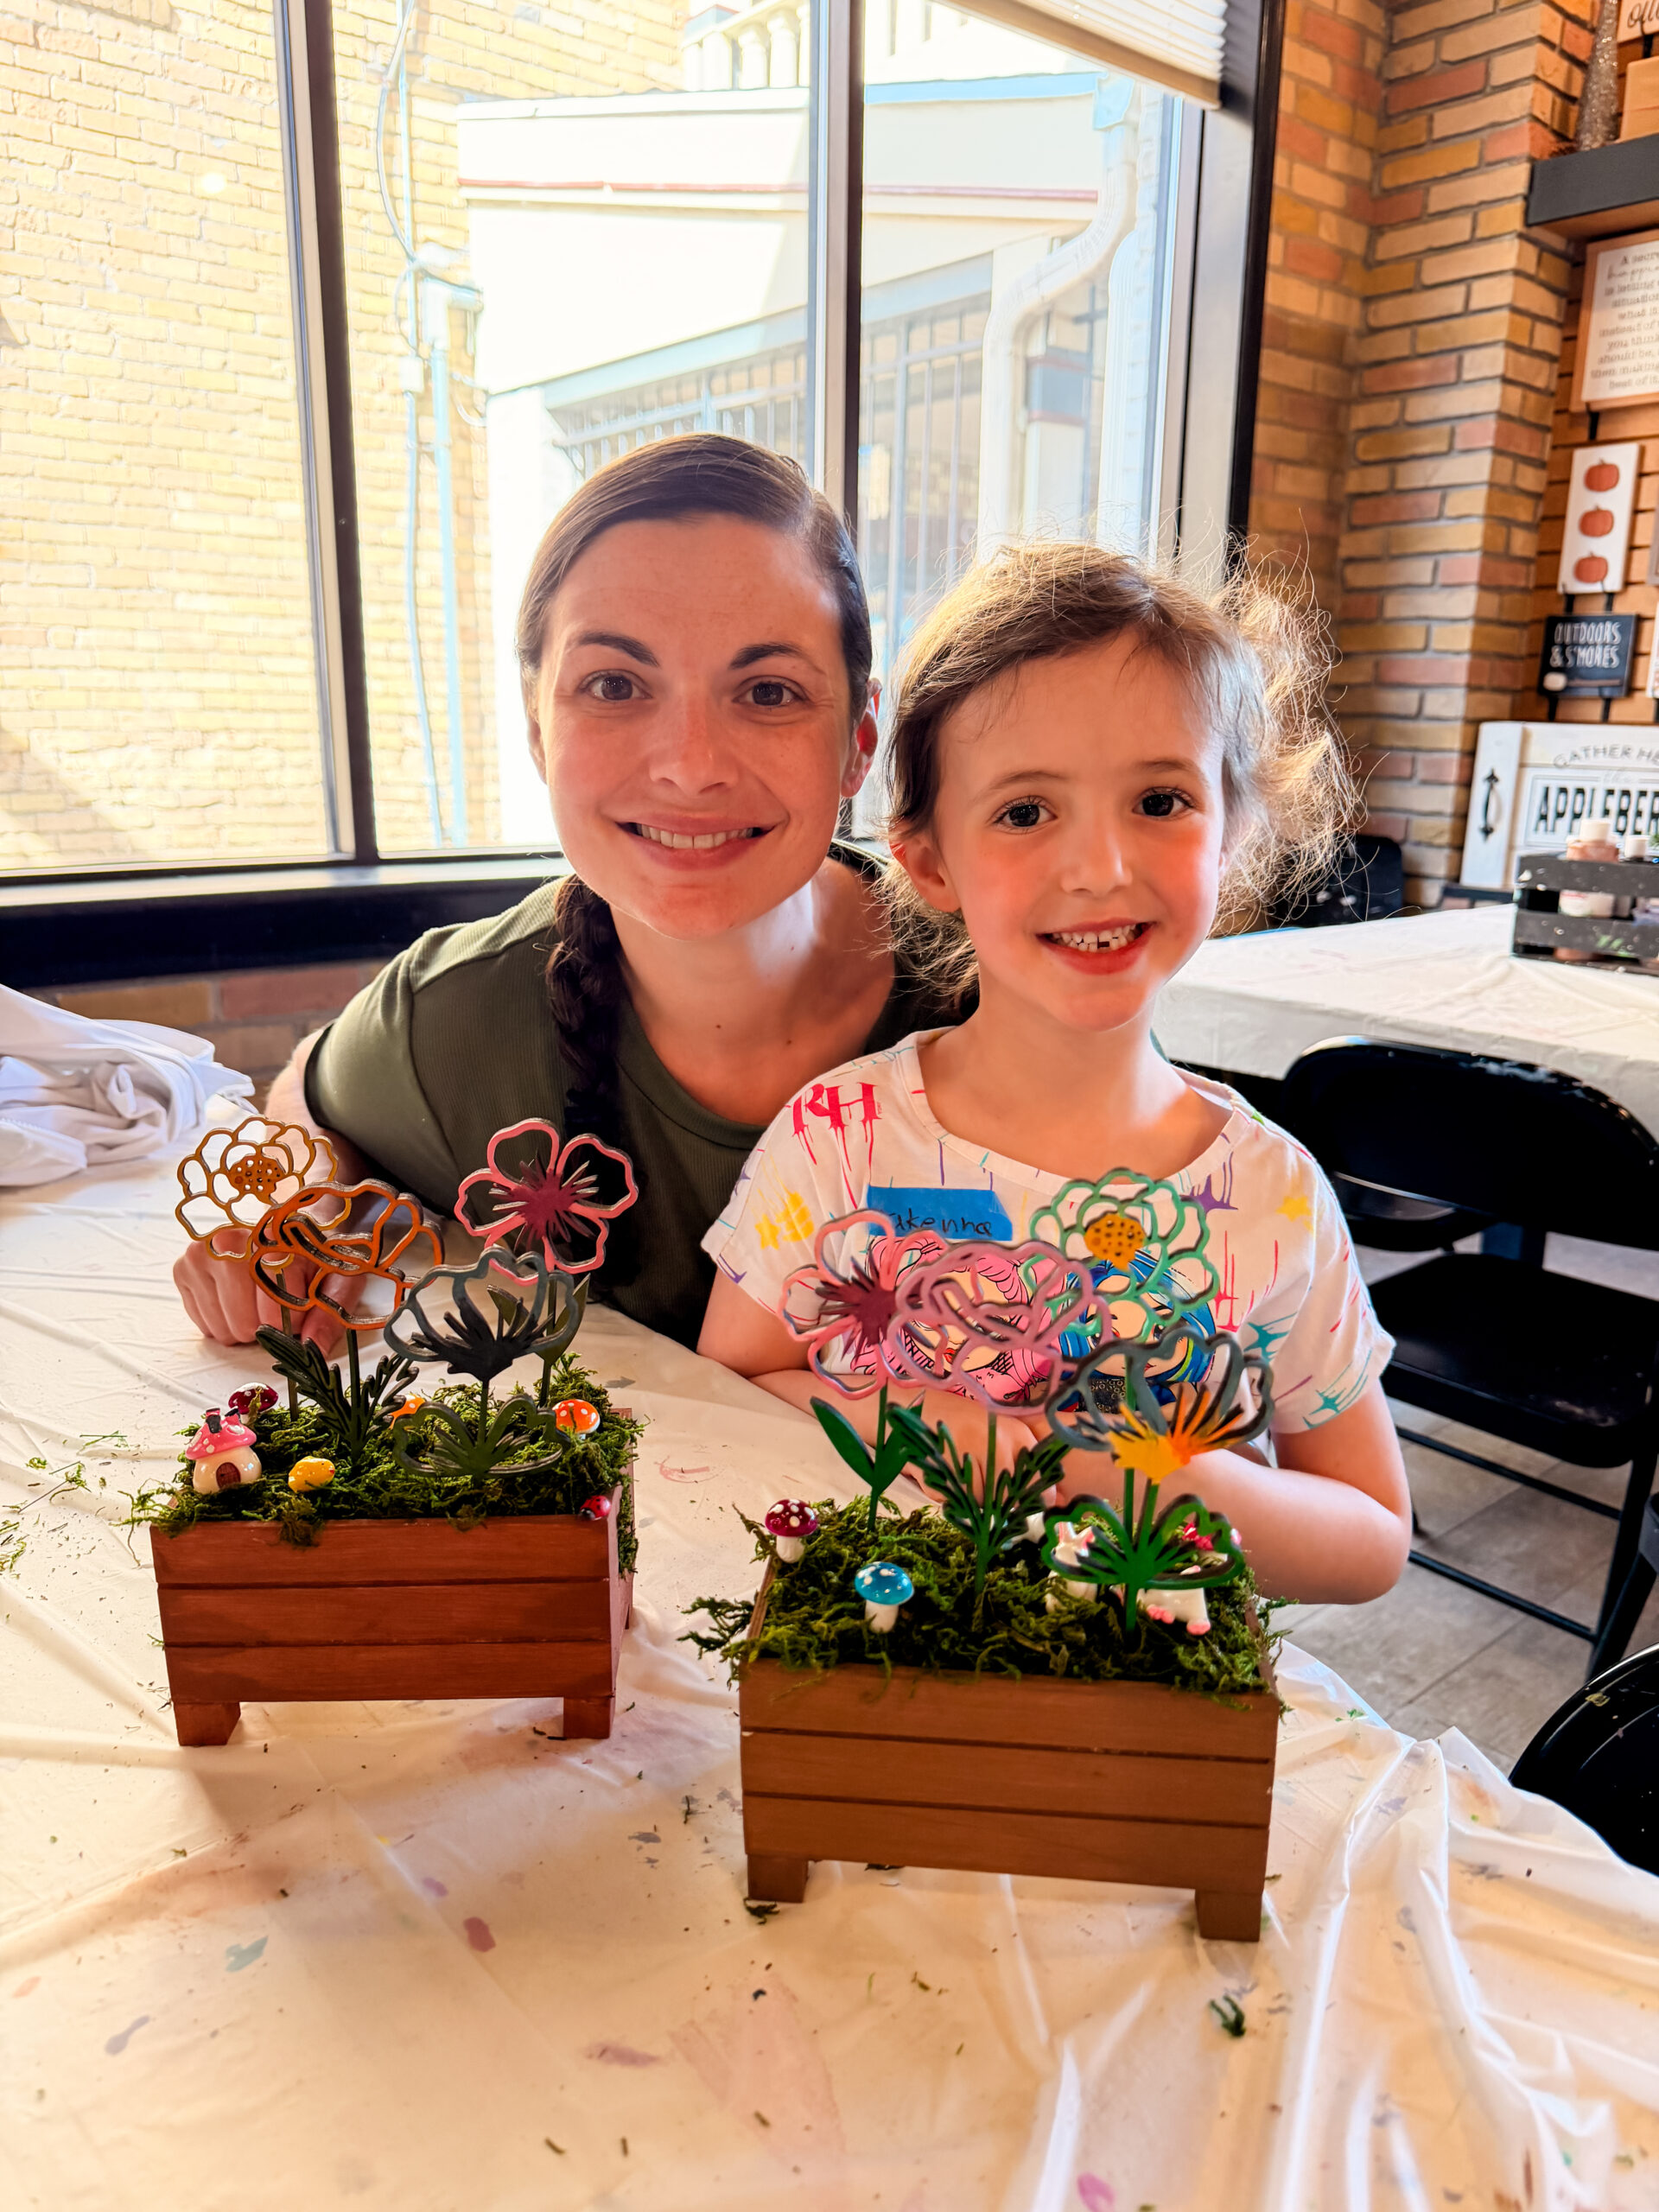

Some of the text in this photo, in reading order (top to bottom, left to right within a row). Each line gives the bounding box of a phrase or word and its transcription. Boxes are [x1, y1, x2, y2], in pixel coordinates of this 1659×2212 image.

[1554, 621, 1622, 645] OUTDOORS
[1549, 645, 1562, 668] &
[1554, 744, 1633, 768] GATHER
